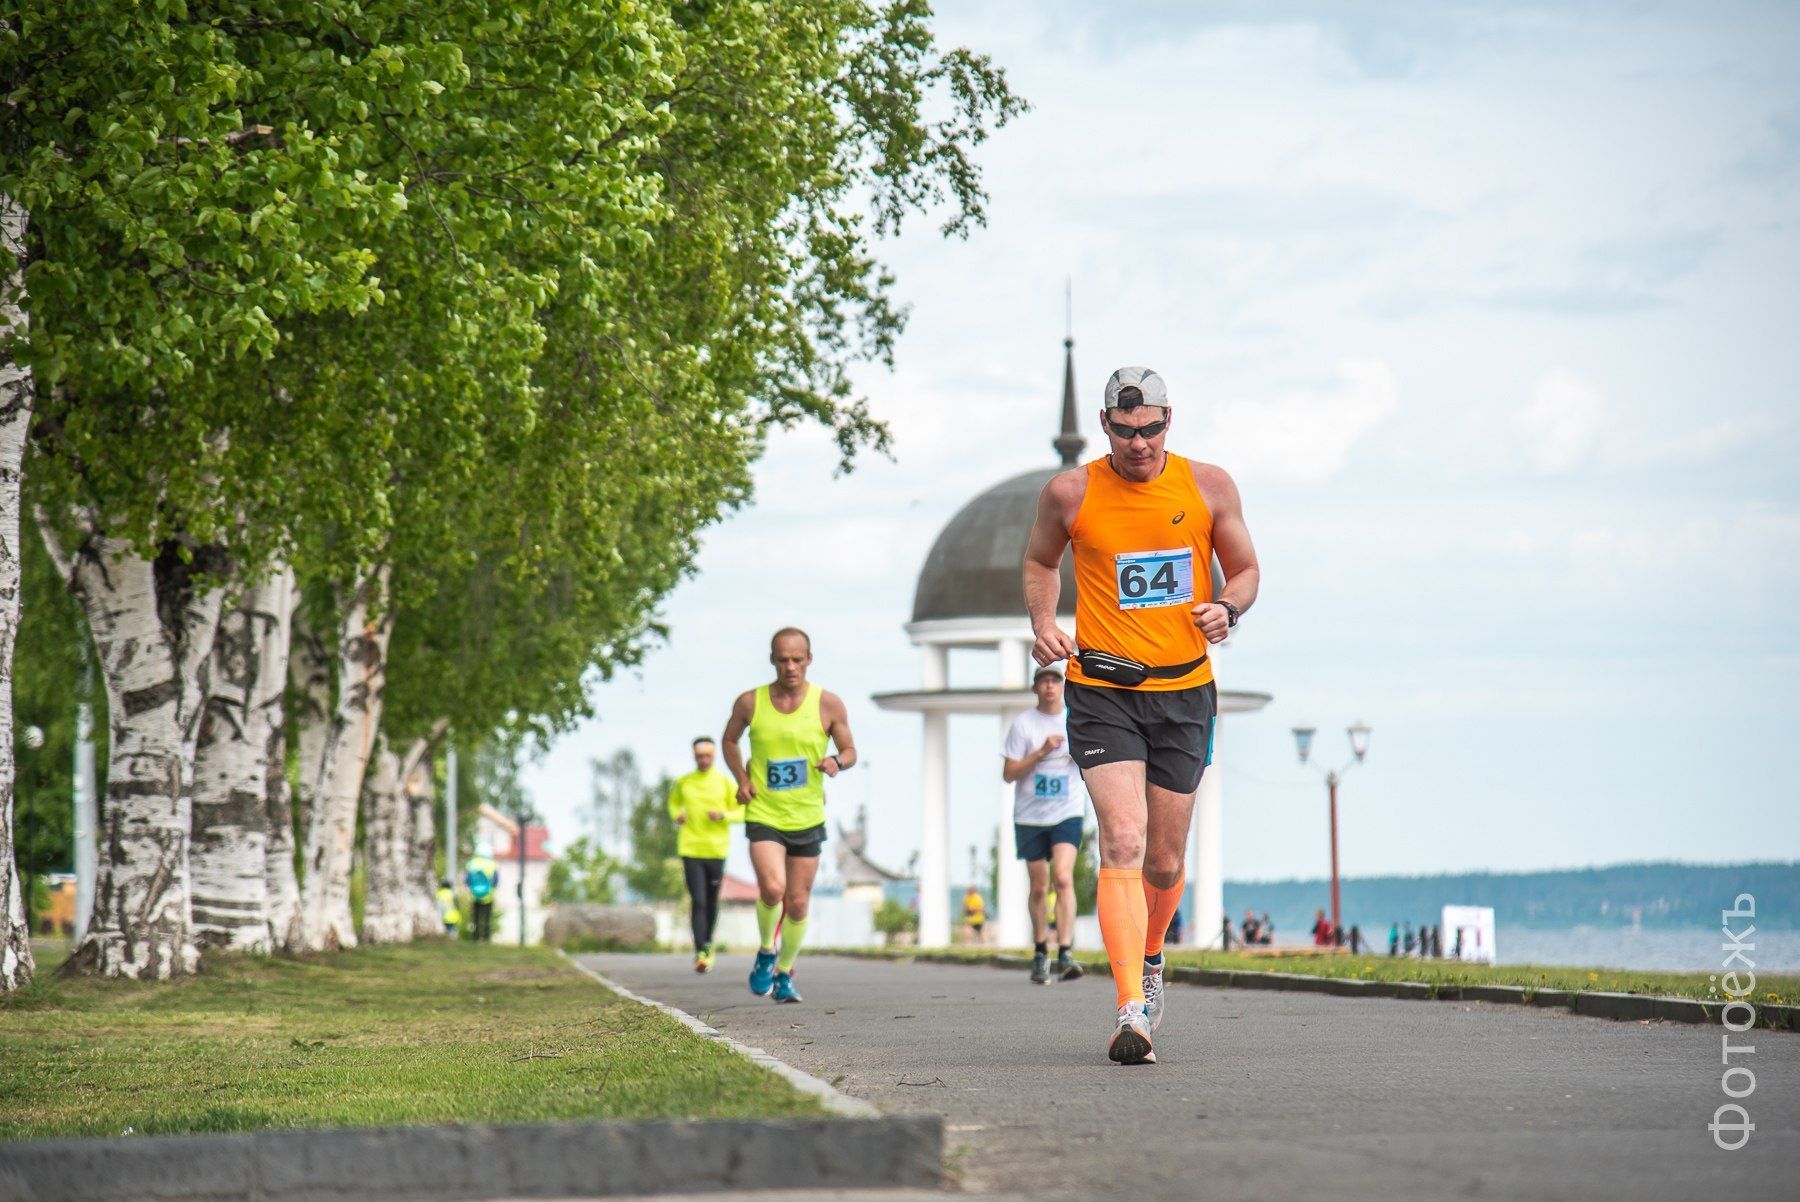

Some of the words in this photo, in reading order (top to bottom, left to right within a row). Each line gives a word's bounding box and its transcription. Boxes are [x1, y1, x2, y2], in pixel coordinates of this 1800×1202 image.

[1120, 562, 1178, 597] 64
[768, 765, 798, 785] 63
[1035, 776, 1061, 793] 49
